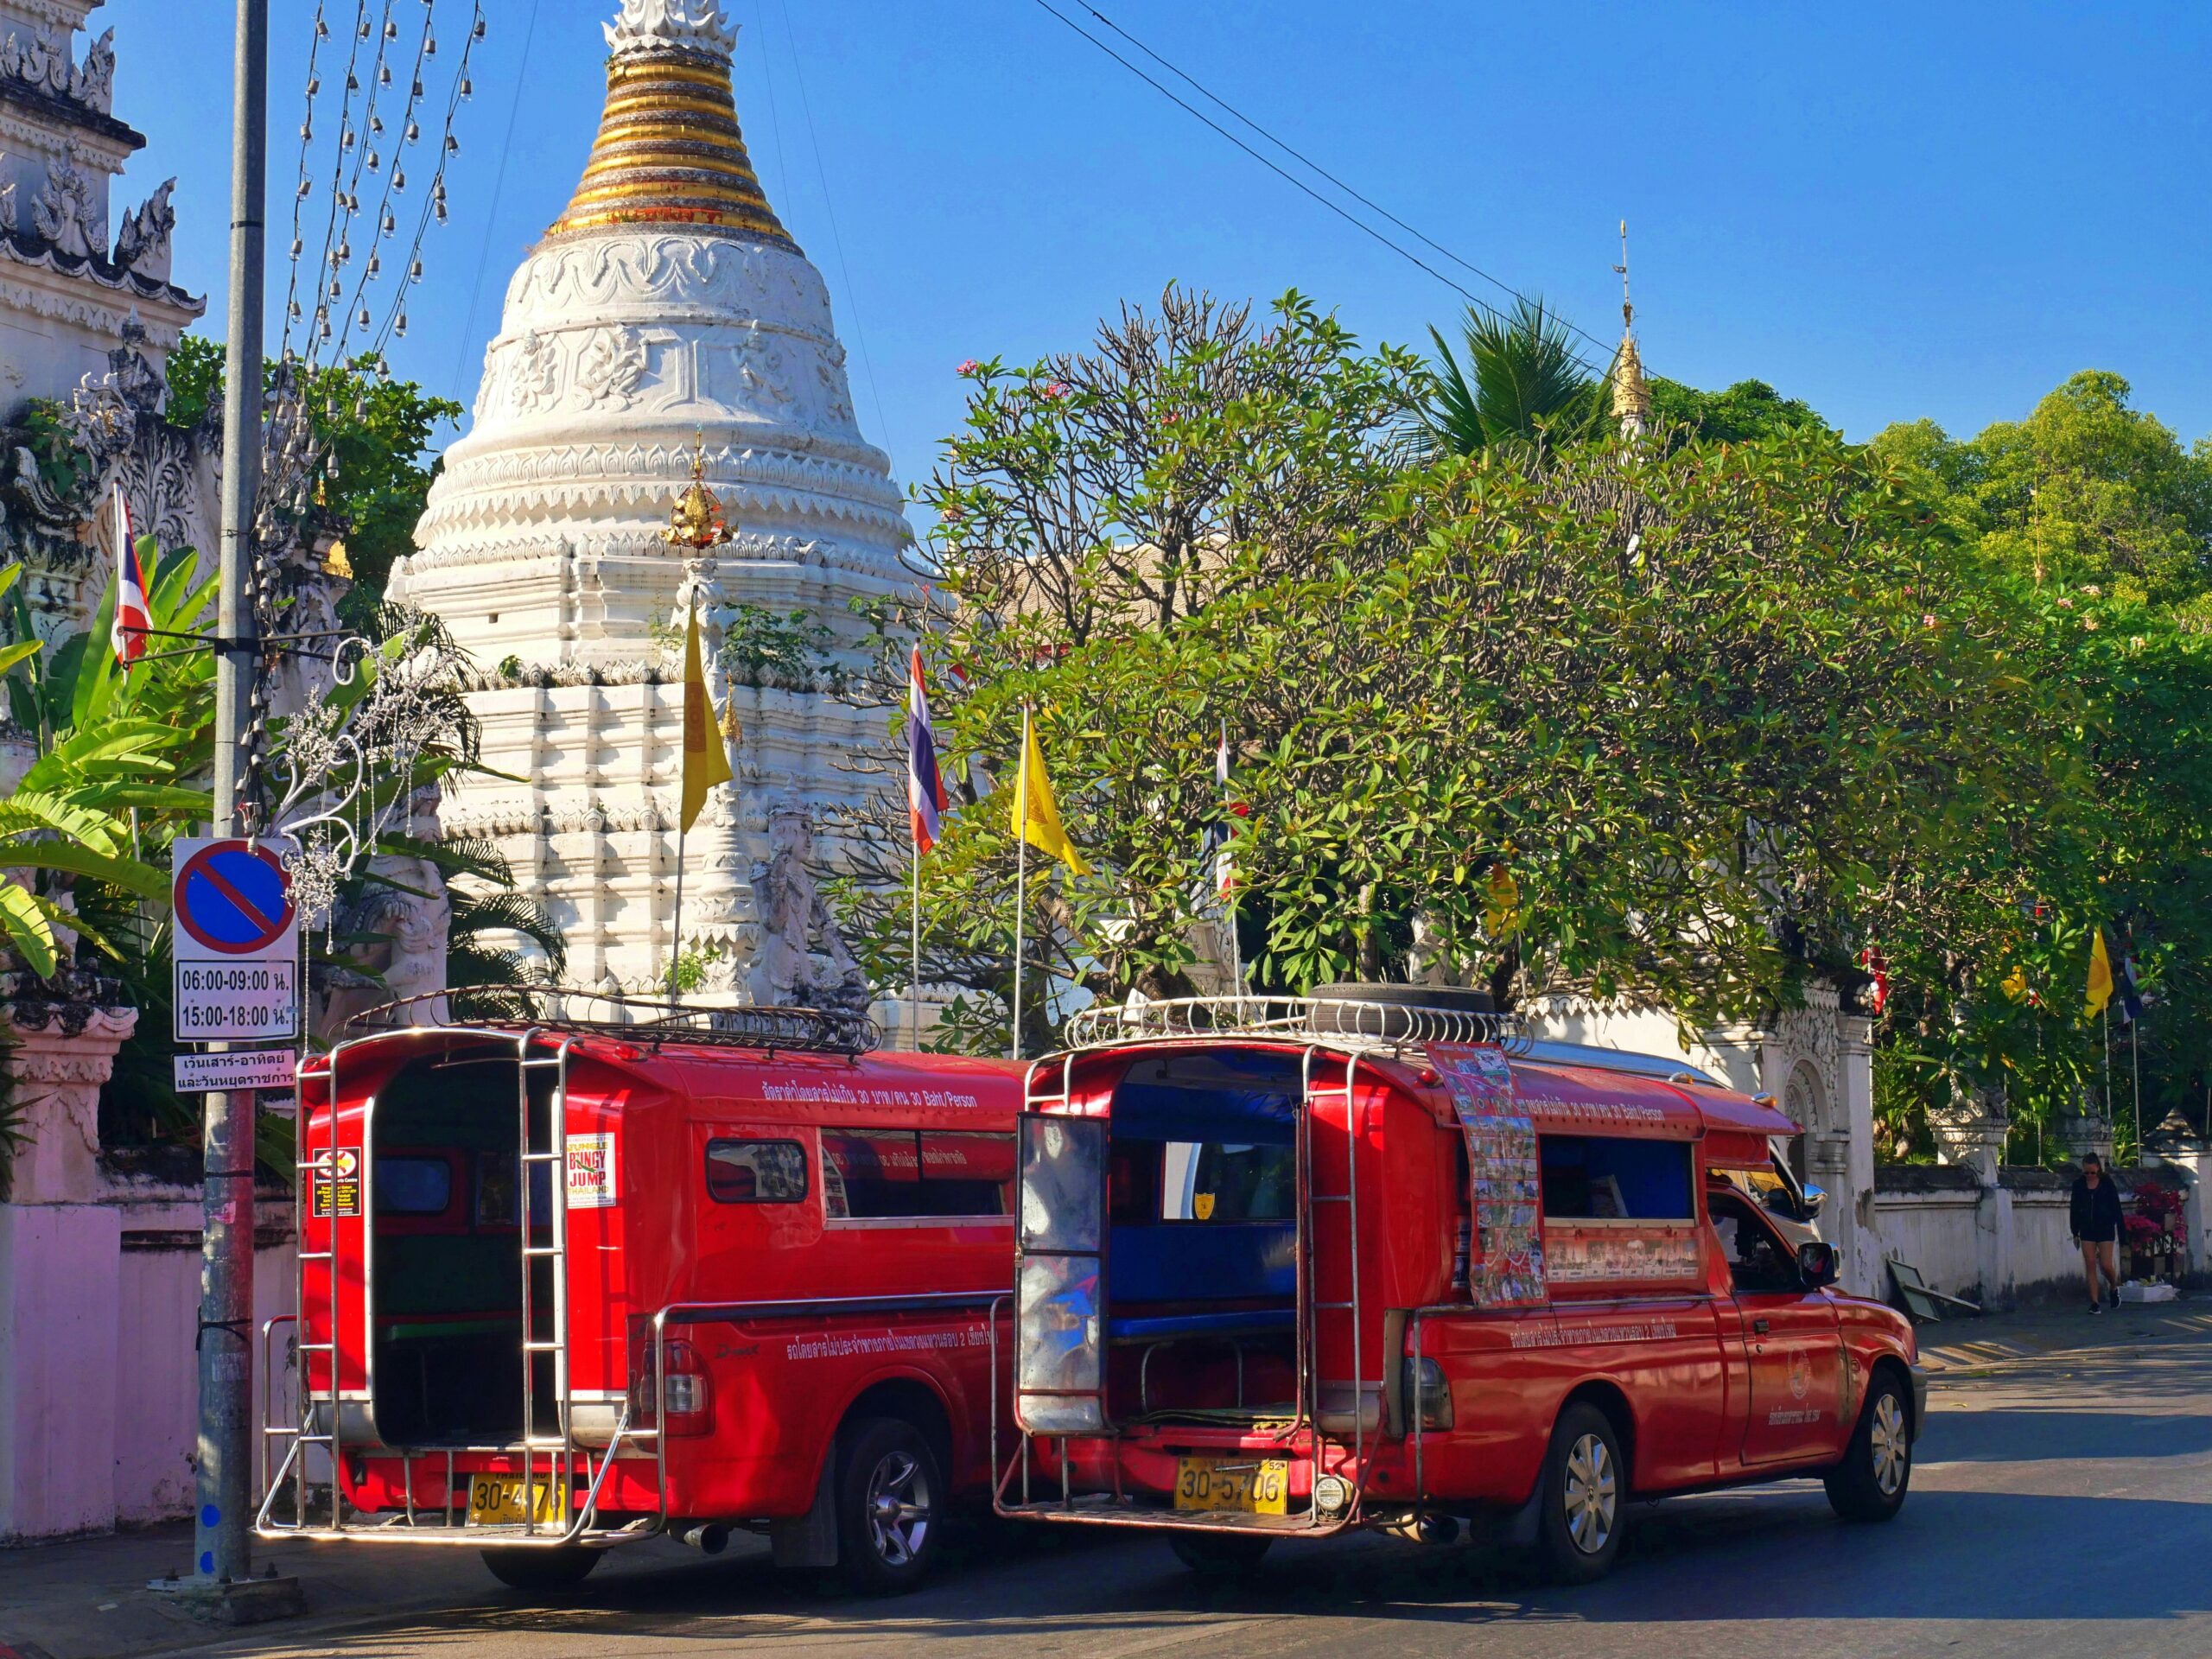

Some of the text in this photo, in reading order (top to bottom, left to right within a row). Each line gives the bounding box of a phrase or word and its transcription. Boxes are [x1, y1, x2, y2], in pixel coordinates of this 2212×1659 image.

[182, 969, 289, 991] 06:00-09:00 น.
[182, 1006, 289, 1027] 15:00-18:00 น.
[184, 1052, 285, 1070] เว้นเสาร์-อาทิตย์
[178, 1070, 295, 1090] และวันหยุดราชการ
[857, 1090, 869, 1105] 30
[871, 1090, 910, 1106] บาท/คน
[910, 1091, 922, 1106] 30
[923, 1090, 978, 1109] Baht/Person
[1620, 1103, 1666, 1122] Baht/Person
[569, 1151, 607, 1170] BUNGY
[569, 1171, 607, 1187] JUMP
[959, 1333, 966, 1347] 2
[1268, 1461, 1281, 1471] 52
[1181, 1471, 1281, 1503] 30-5706
